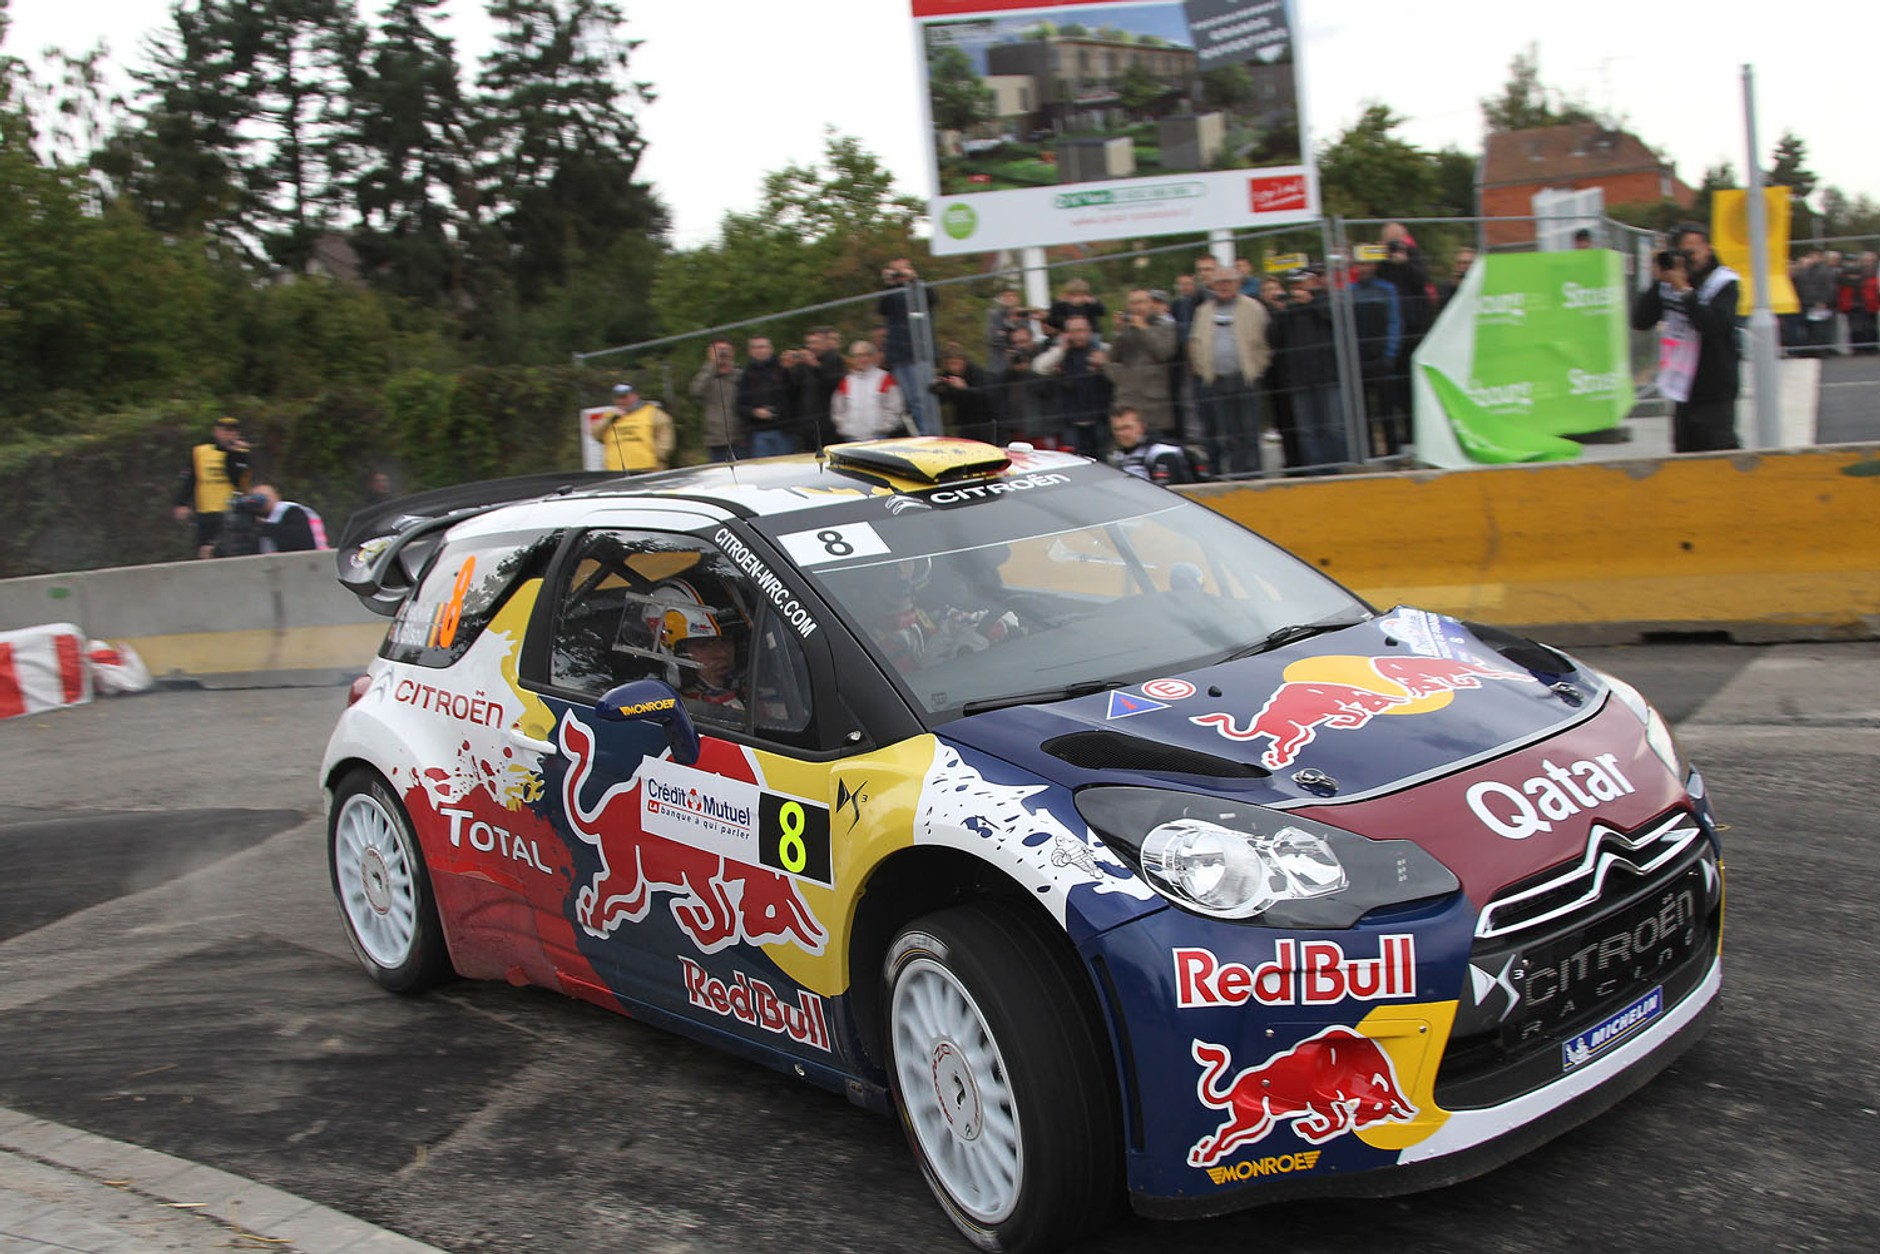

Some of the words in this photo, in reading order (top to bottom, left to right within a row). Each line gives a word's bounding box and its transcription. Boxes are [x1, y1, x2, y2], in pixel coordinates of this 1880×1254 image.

[817, 530, 854, 556] 8
[439, 554, 477, 649] 8
[715, 527, 818, 640] CITROEN-WRC.COM
[395, 680, 504, 729] CITROËN
[622, 698, 673, 715] MONROE
[1159, 682, 1184, 695] E
[648, 778, 686, 807] Crédit
[703, 795, 750, 826] Mutuel
[661, 805, 691, 823] banque
[703, 821, 718, 833] qui
[720, 826, 750, 841] parler
[1466, 753, 1635, 840] Qatar
[440, 807, 553, 875] TOTAL
[779, 801, 806, 873] 8
[1173, 938, 1294, 1007] Red
[1302, 934, 1415, 1005] Bull
[679, 956, 755, 1025] Red
[752, 978, 831, 1052] Bull
[1590, 994, 1658, 1047] MICHELIN
[1214, 1152, 1314, 1184] MONROE
